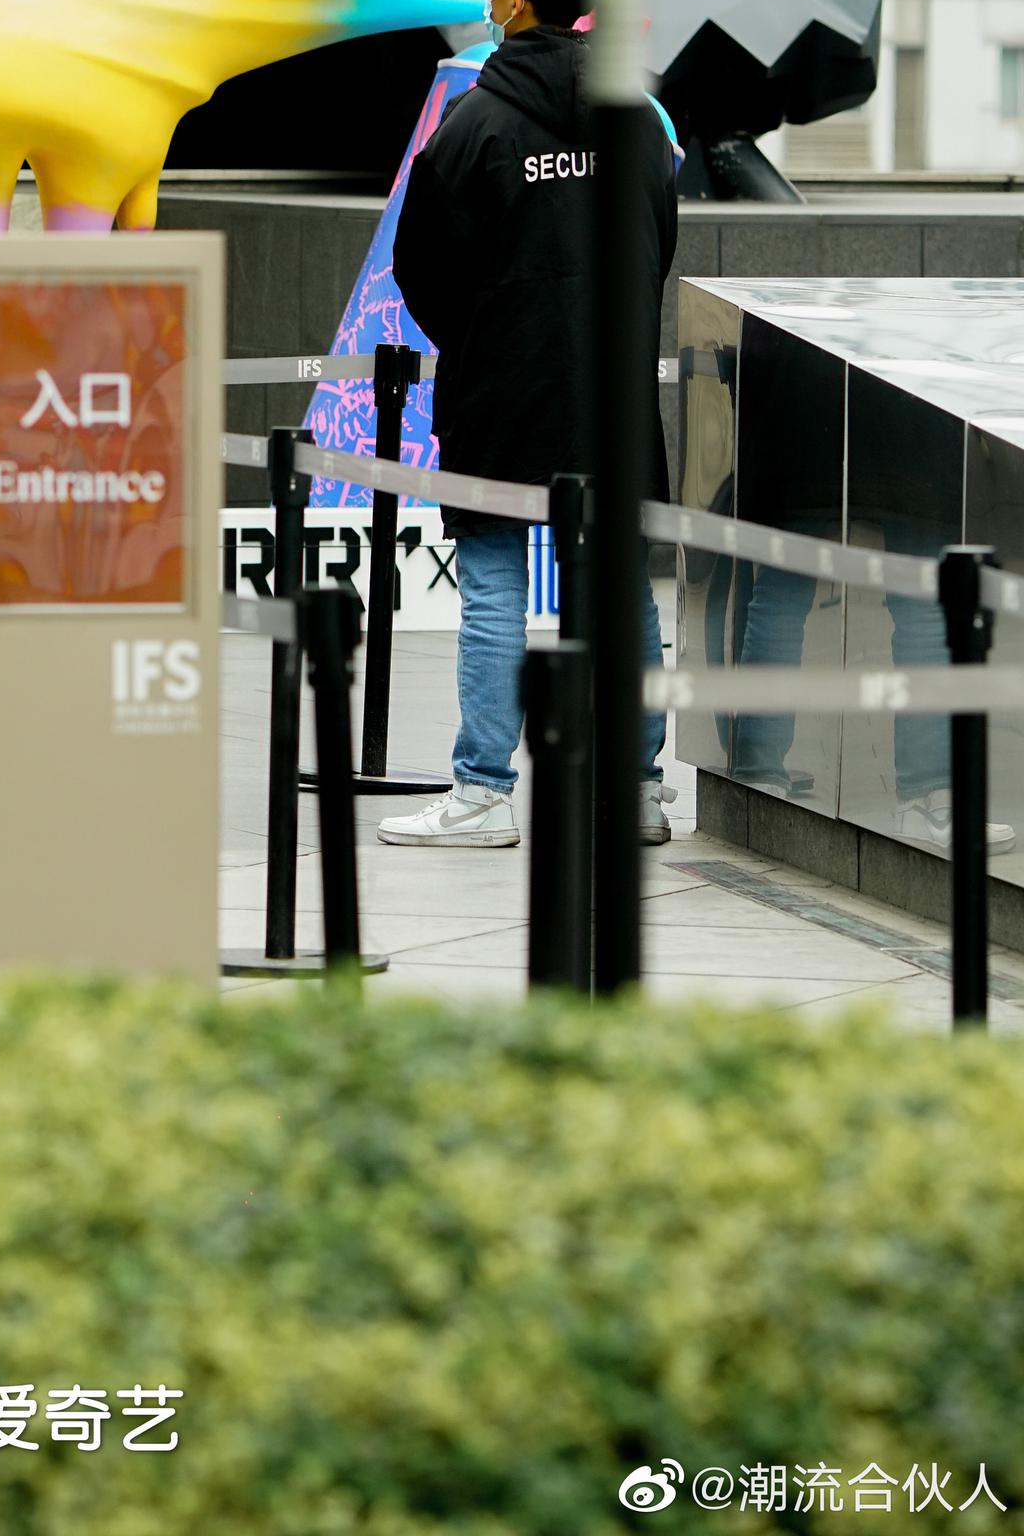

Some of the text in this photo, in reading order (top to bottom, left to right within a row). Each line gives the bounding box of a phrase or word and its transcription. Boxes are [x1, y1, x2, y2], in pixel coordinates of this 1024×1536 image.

[20, 368, 132, 428] 入口
[297, 359, 323, 378] IFS
[112, 640, 202, 701] IFS
